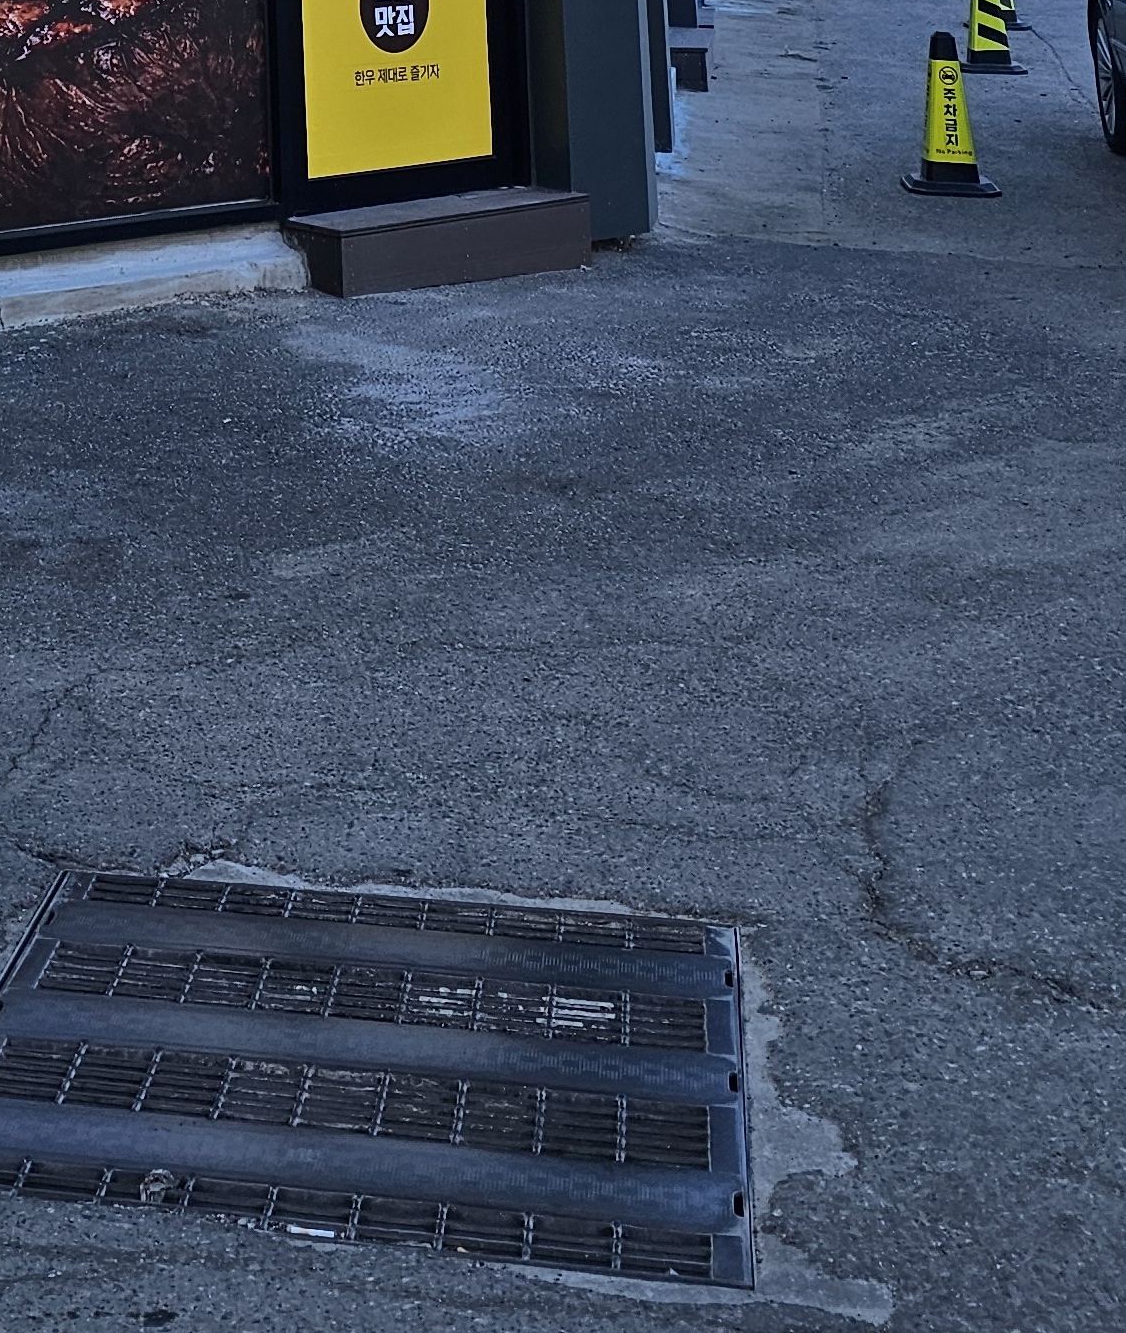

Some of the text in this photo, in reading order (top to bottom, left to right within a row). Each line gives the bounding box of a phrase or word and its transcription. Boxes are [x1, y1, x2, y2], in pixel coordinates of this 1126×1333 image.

[374, 4, 414, 38] 맛집
[354, 64, 439, 86] 한우 제대로 즐기자
[943, 88, 958, 146] 주차금지
